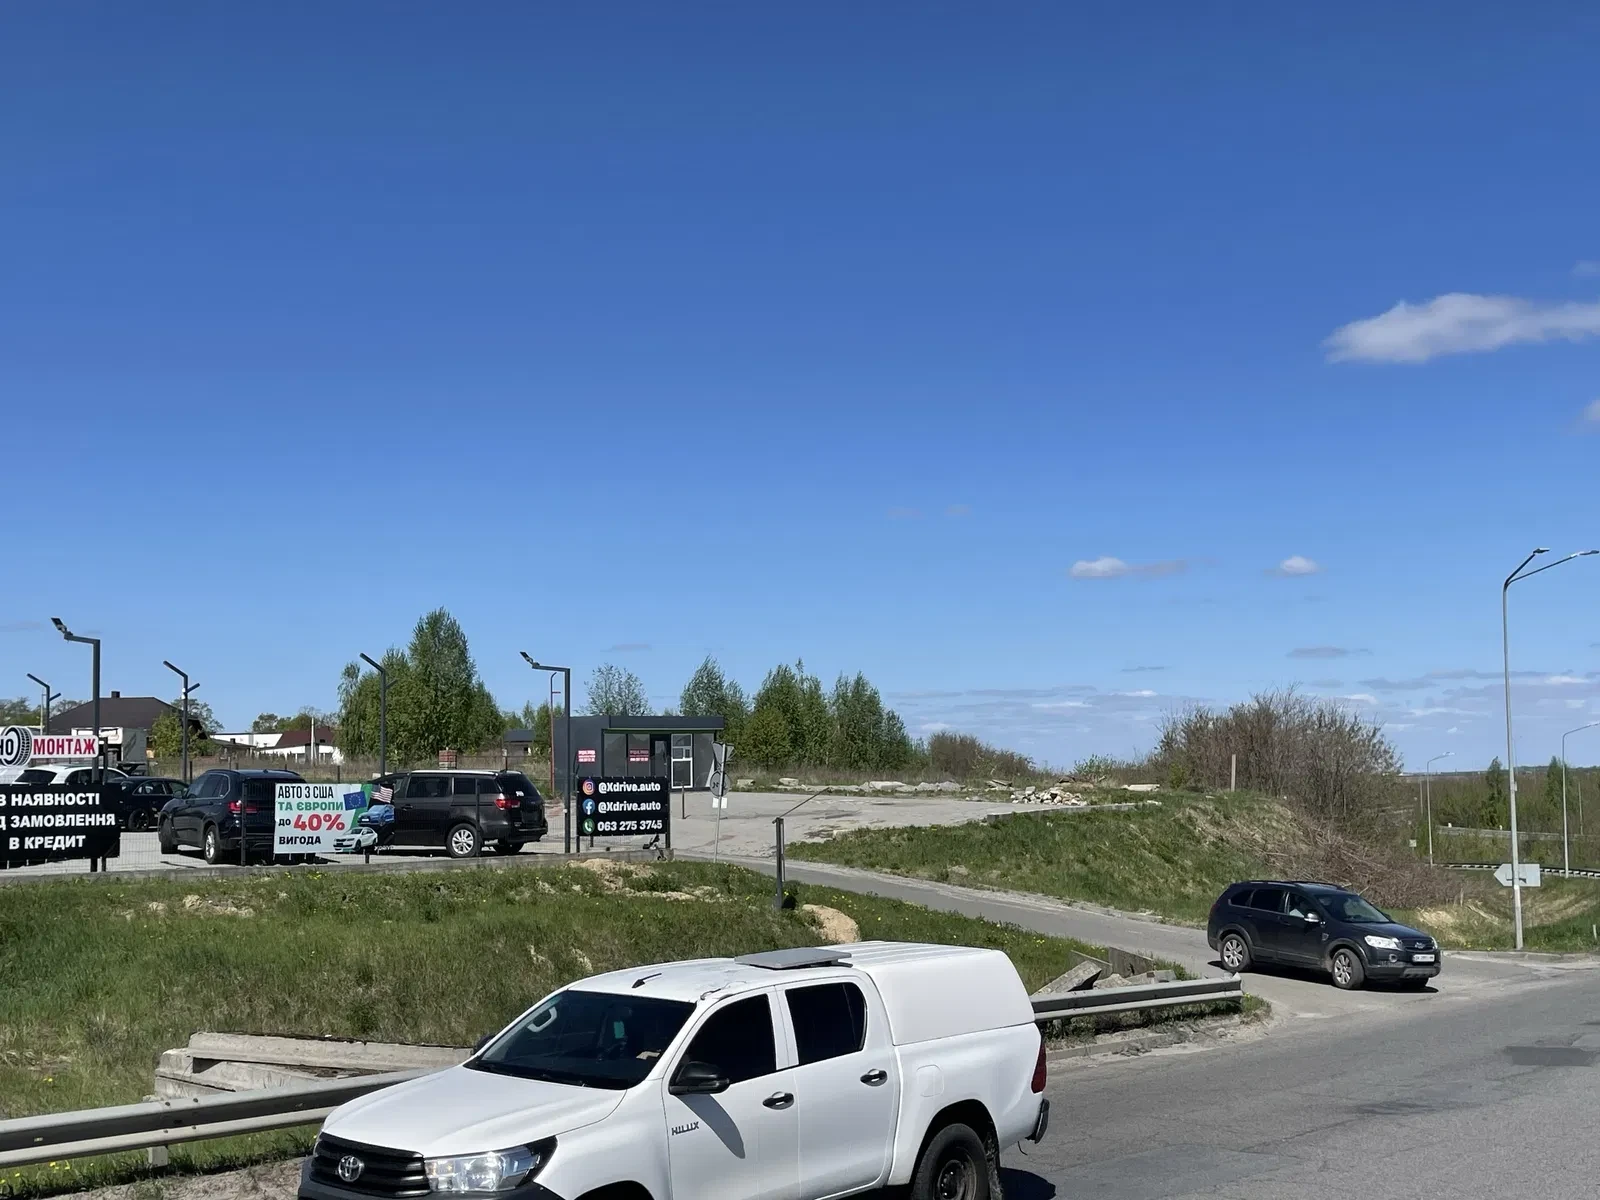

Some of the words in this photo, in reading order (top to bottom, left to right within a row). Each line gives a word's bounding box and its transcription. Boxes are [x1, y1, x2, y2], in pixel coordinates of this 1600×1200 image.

[33, 738, 96, 755] МОНТАЖ
[278, 786, 302, 799] АВТО
[312, 786, 334, 798] США
[598, 782, 661, 794] @Xdrive.auto
[11, 793, 100, 806] НАЯВНОСТІ
[278, 802, 293, 811] ТА
[296, 801, 344, 811] ЄВРОПИ
[598, 801, 661, 813] @Xdrive.auto
[10, 814, 116, 828] ЗАМОВЛЕННЯ
[293, 814, 345, 831] 40%
[597, 821, 617, 831] 063
[619, 821, 638, 831] 275
[639, 820, 663, 830] 3745
[9, 837, 20, 850] В
[24, 835, 86, 850] КРЕДИТ
[279, 836, 322, 845] ВИГОДА
[671, 1121, 700, 1136] HILUX
